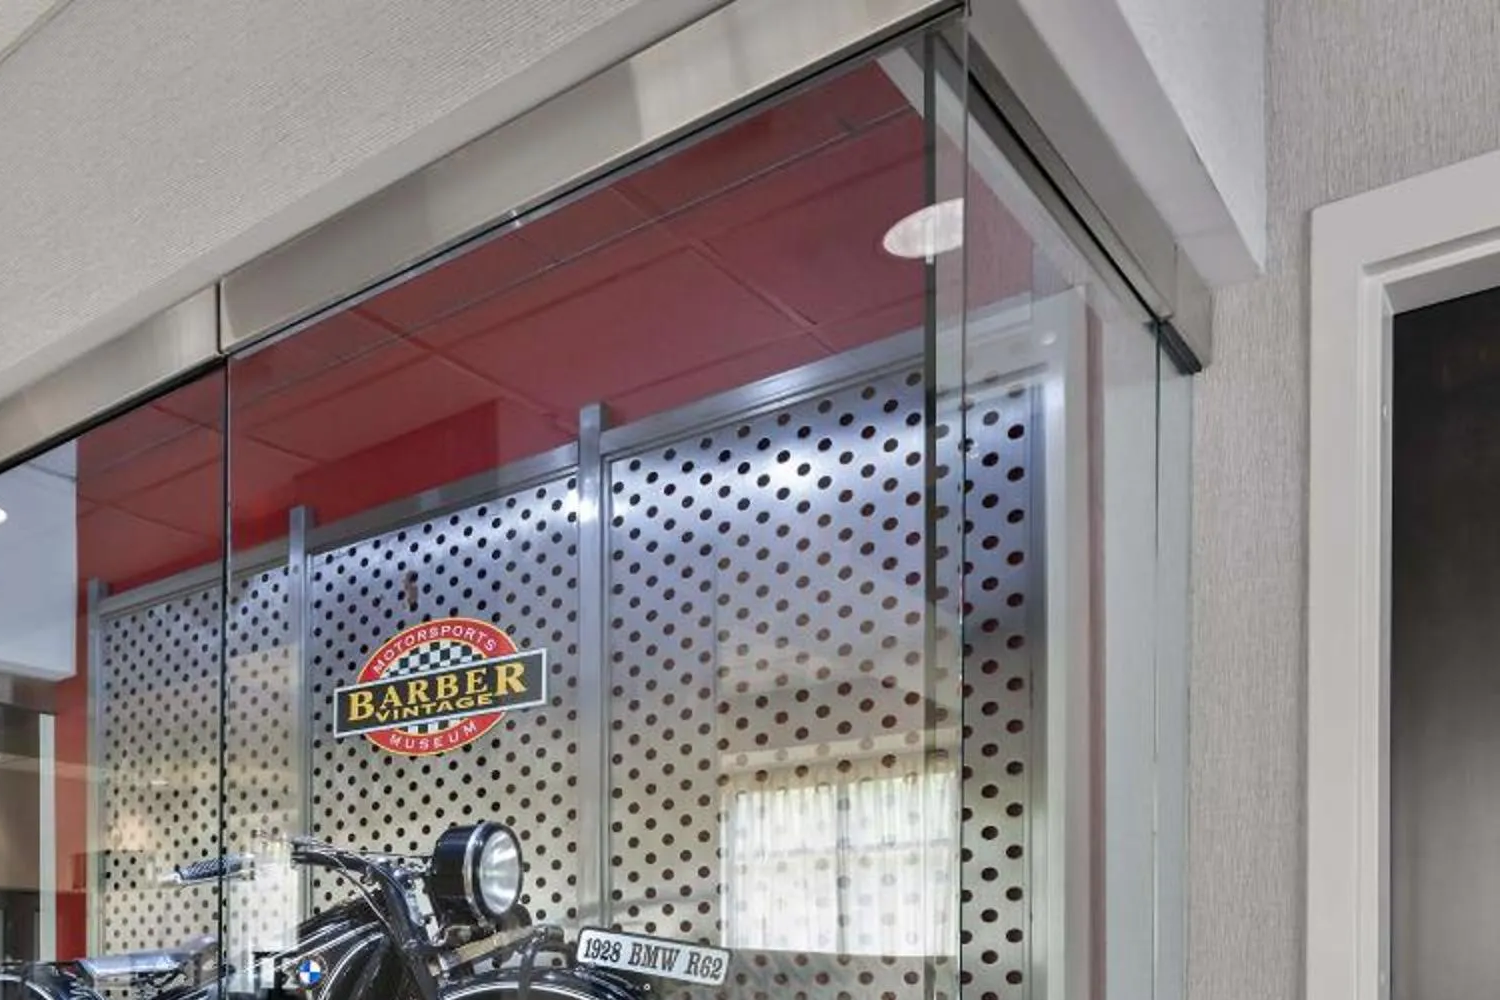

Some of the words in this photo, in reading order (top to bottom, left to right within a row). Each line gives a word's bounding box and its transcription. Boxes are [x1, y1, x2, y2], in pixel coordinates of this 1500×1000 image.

[372, 625, 497, 674] MOTORSPORTS
[348, 661, 528, 721] BARBER
[375, 692, 493, 723] VINTAGE
[389, 722, 477, 750] MUSEUM
[583, 937, 622, 963] 1928
[628, 942, 680, 972] BMW
[685, 951, 723, 981] R62
